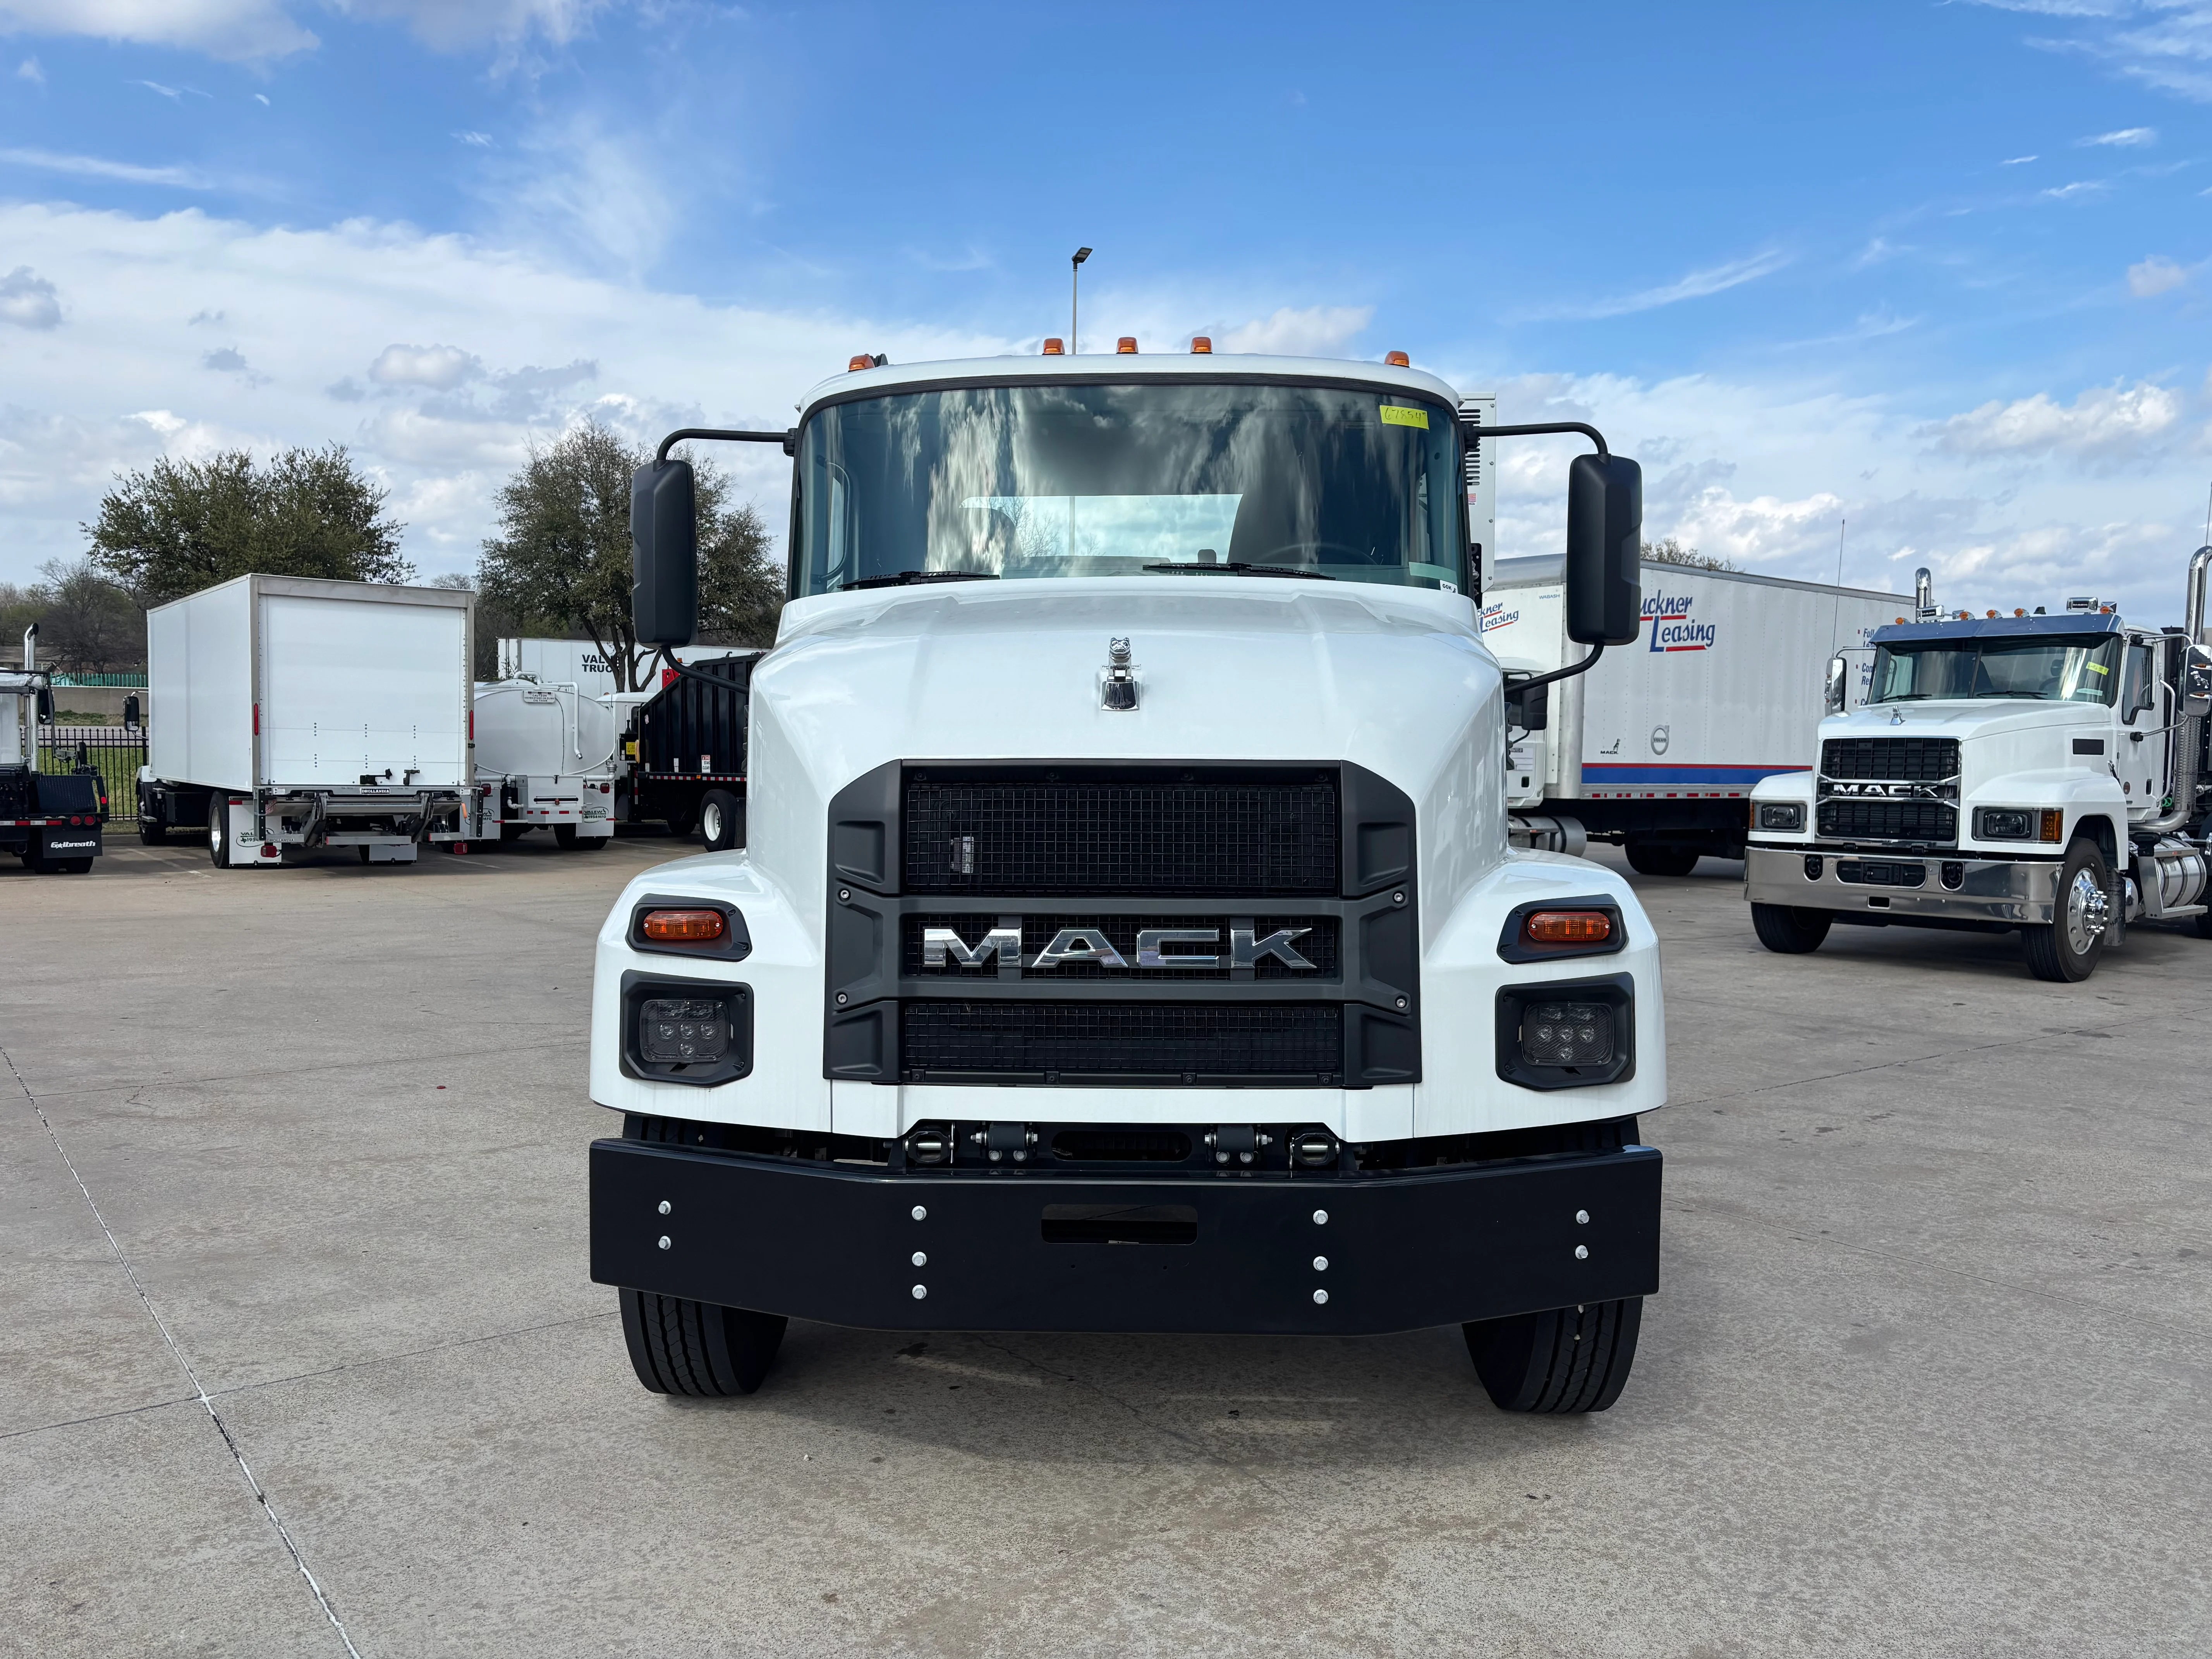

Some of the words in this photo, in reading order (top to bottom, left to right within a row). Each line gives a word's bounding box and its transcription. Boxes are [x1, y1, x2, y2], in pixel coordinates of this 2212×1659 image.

[1649, 616, 1716, 653] Leasing
[582, 664, 613, 673] TRUC
[1833, 784, 1938, 798] MACK
[922, 927, 1317, 969] MACK
